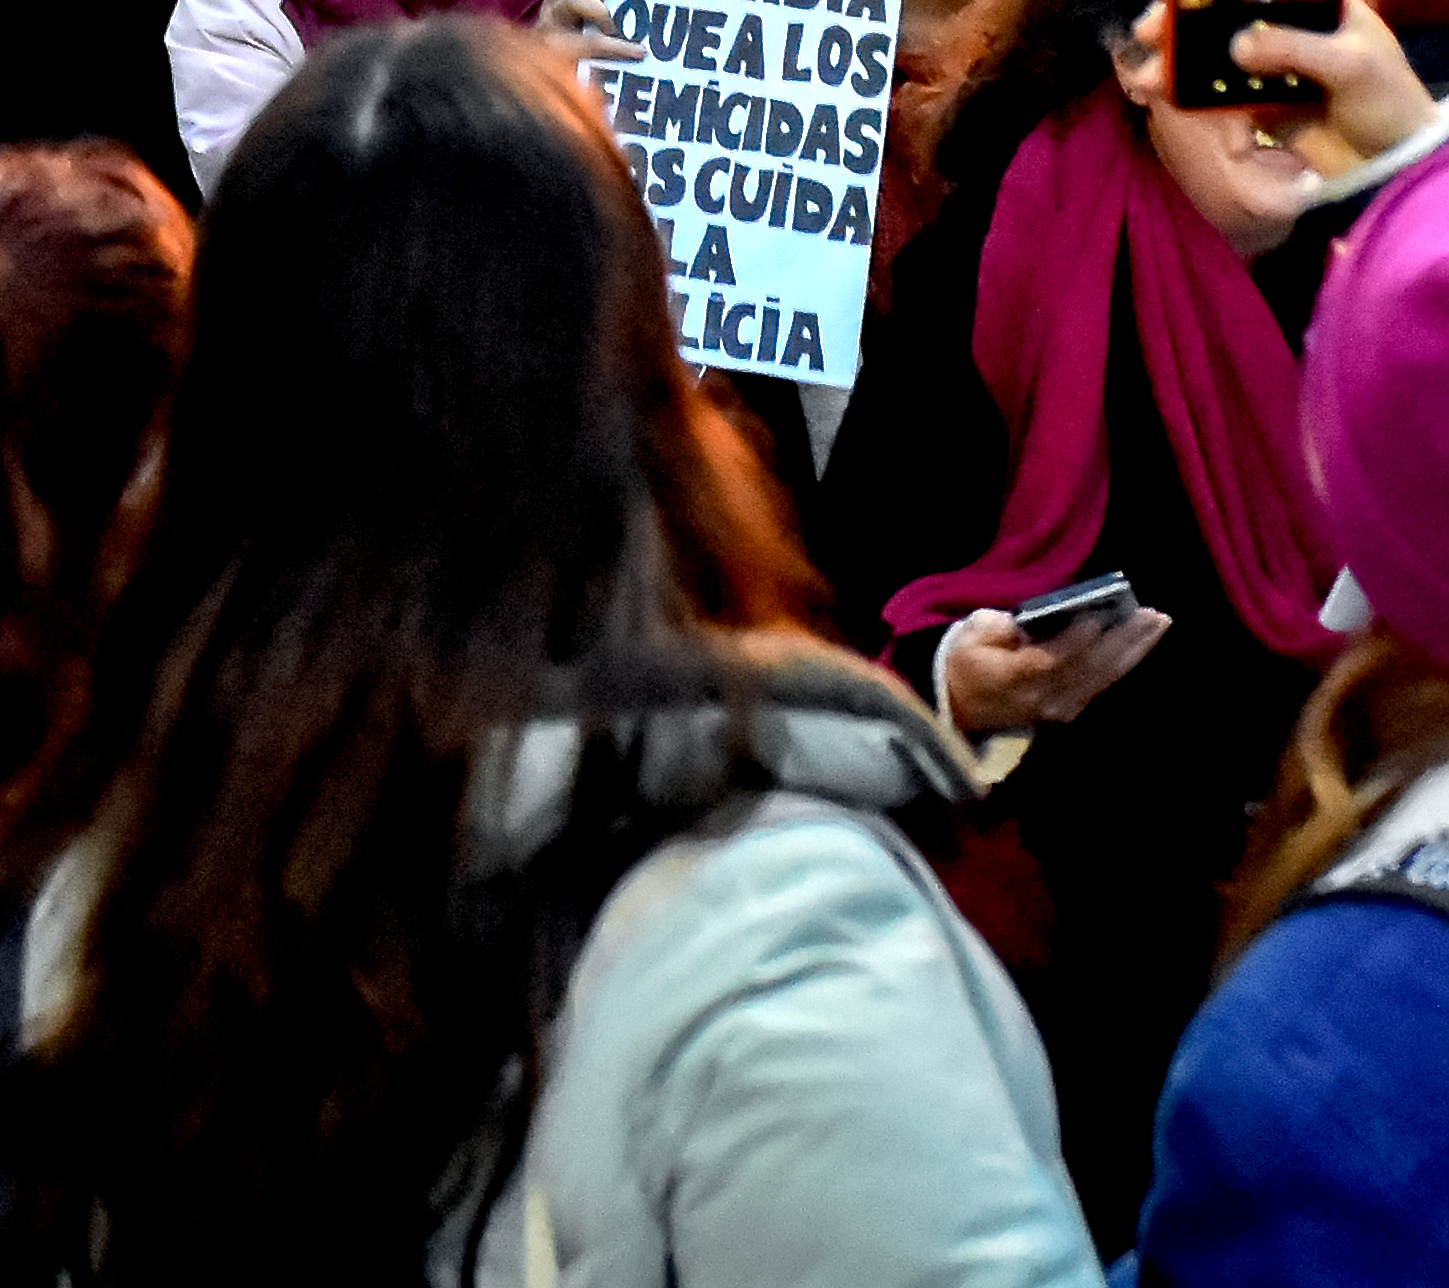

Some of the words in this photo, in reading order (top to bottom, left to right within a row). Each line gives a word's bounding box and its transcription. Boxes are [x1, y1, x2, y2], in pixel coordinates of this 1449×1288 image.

[782, 23, 892, 99] LOS
[693, 156, 872, 246] CUIDA
[668, 290, 826, 373] LICIA
